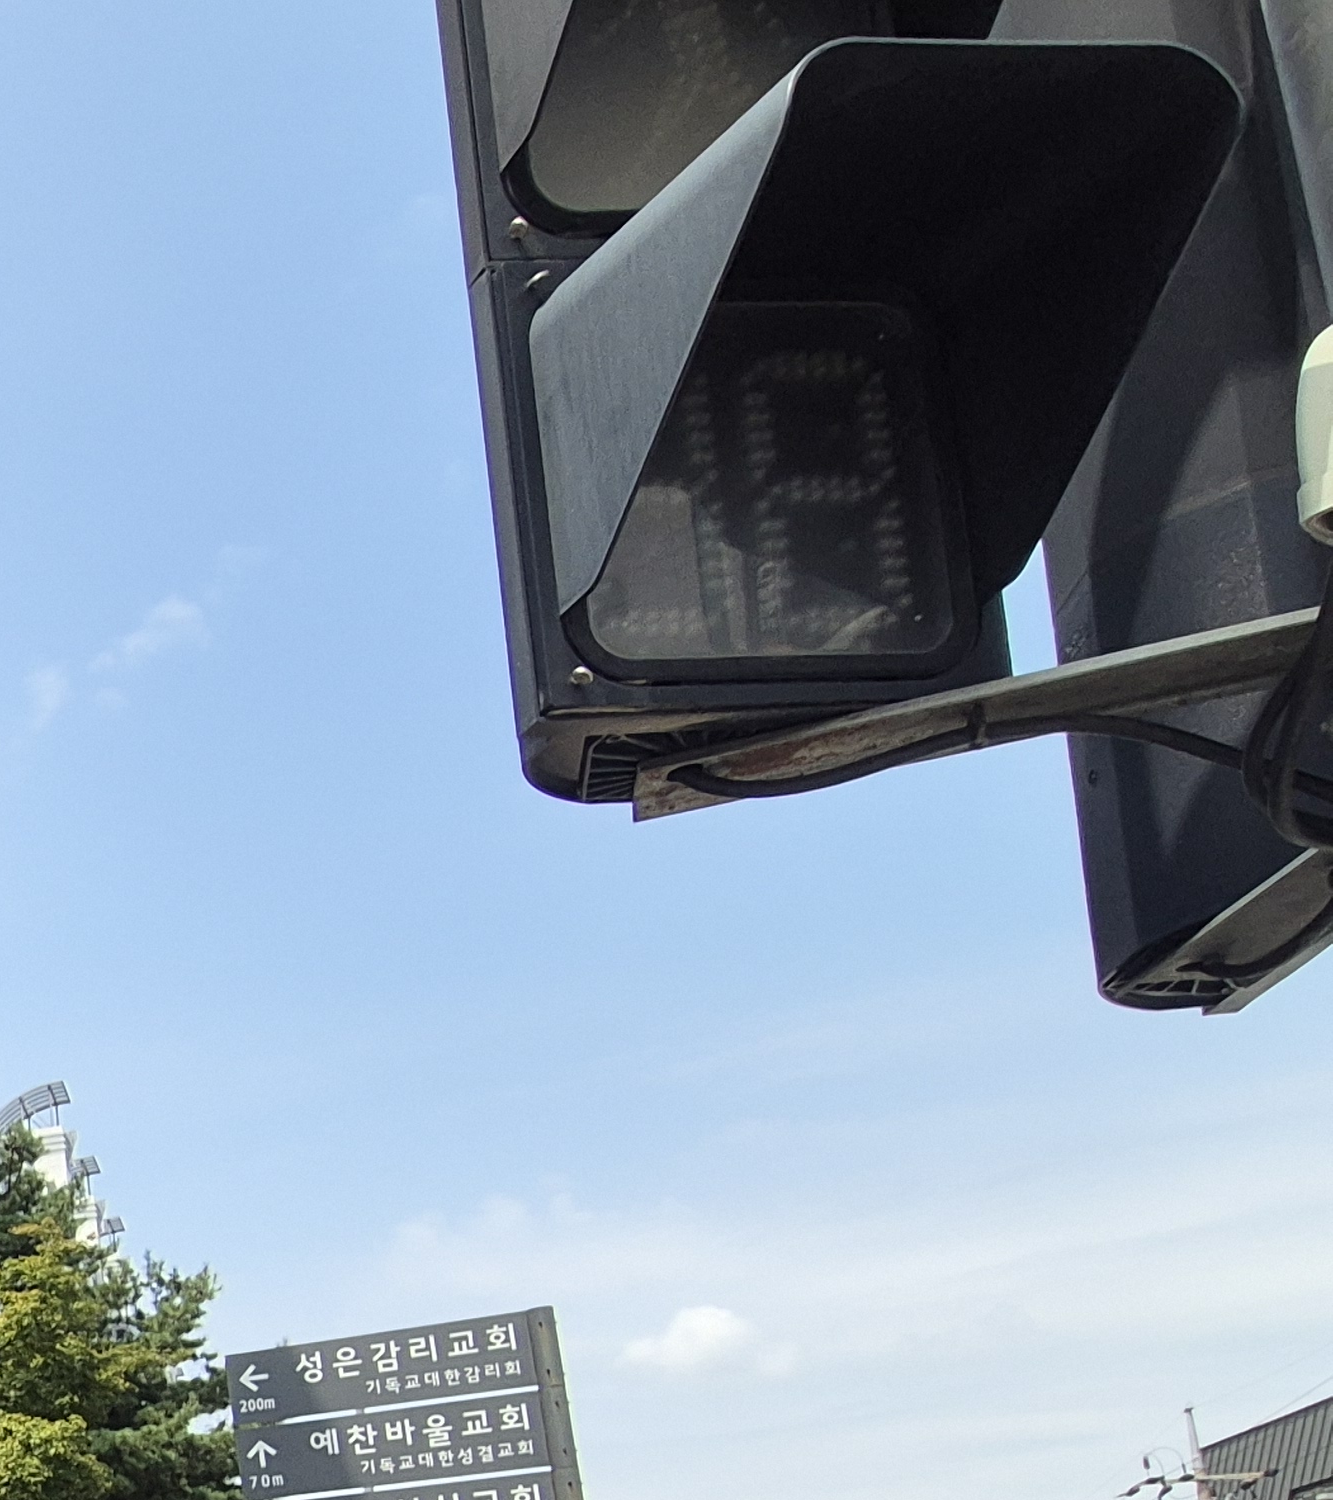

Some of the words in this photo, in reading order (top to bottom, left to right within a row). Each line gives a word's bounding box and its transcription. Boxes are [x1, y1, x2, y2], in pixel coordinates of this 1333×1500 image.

[295, 1322, 518, 1384] 성은감리교회
[365, 1359, 522, 1395] 기독교대한감리회
[239, 1397, 276, 1414] 200m
[309, 1402, 531, 1457] 예찬바울교회
[360, 1438, 535, 1475] 기독교대한성결교회
[249, 1473, 284, 1489] 70m
